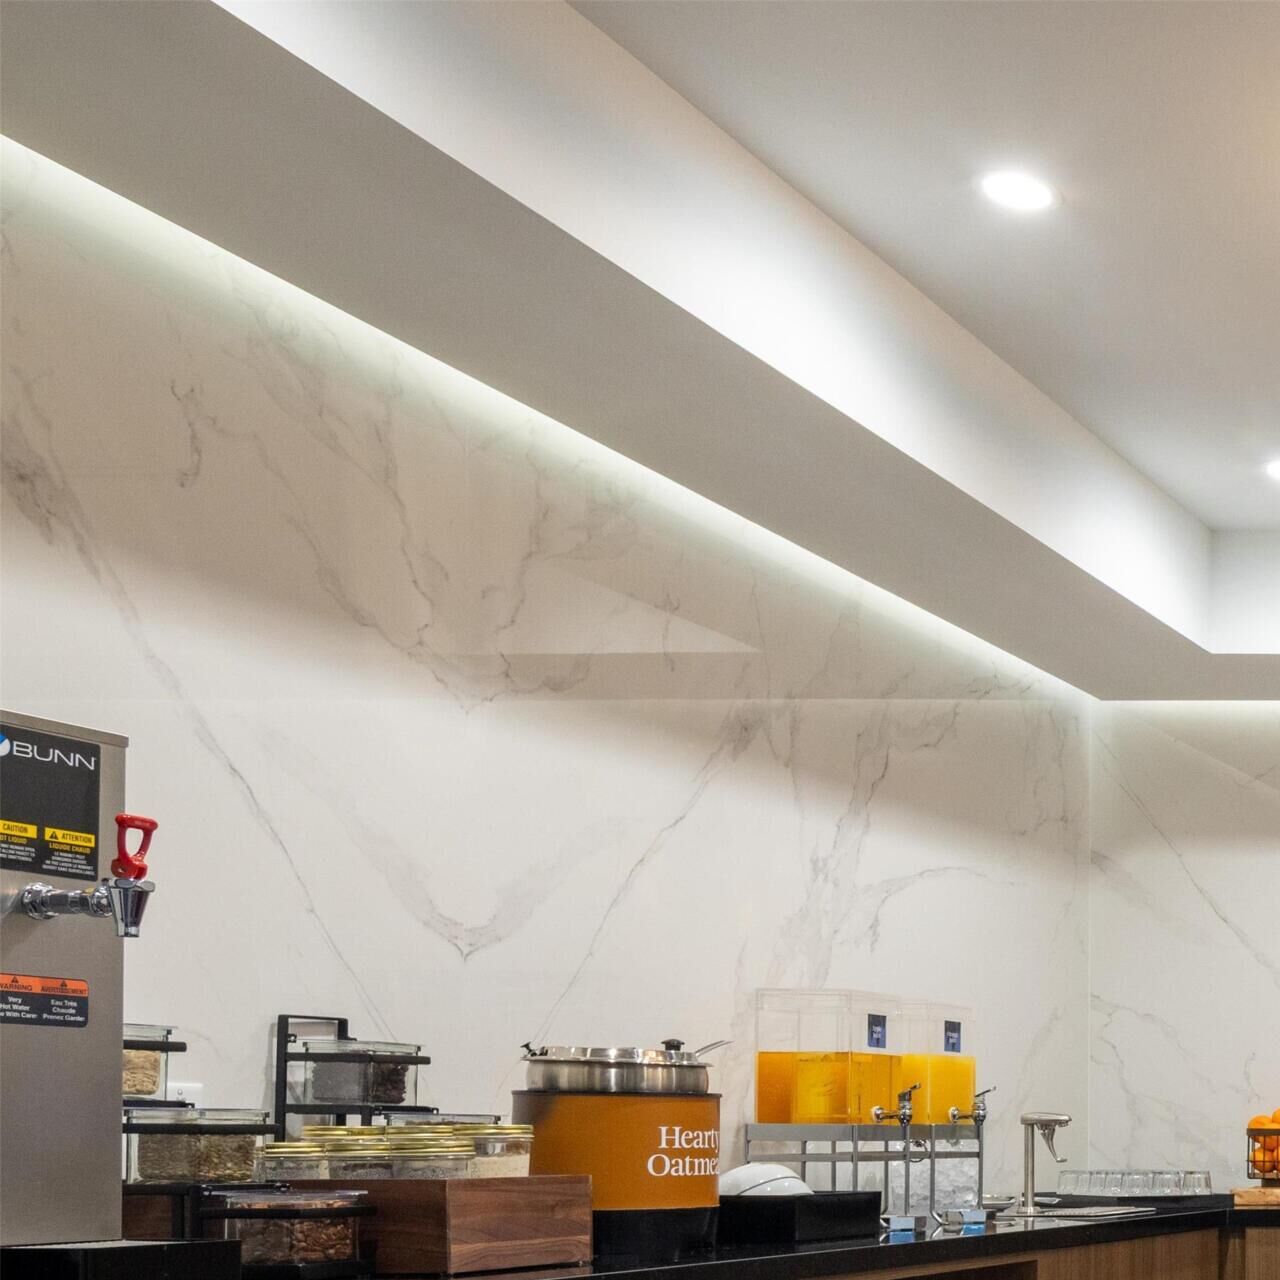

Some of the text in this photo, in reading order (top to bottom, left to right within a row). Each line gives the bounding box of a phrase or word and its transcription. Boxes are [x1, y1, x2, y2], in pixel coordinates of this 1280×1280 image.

[13, 741, 95, 770] BUNN
[3, 823, 28, 834] CAUTION
[62, 832, 92, 844] ATTENTION
[8, 996, 22, 1004] Very
[658, 1126, 719, 1153] Hearty
[647, 1153, 720, 1176] Oatmea
